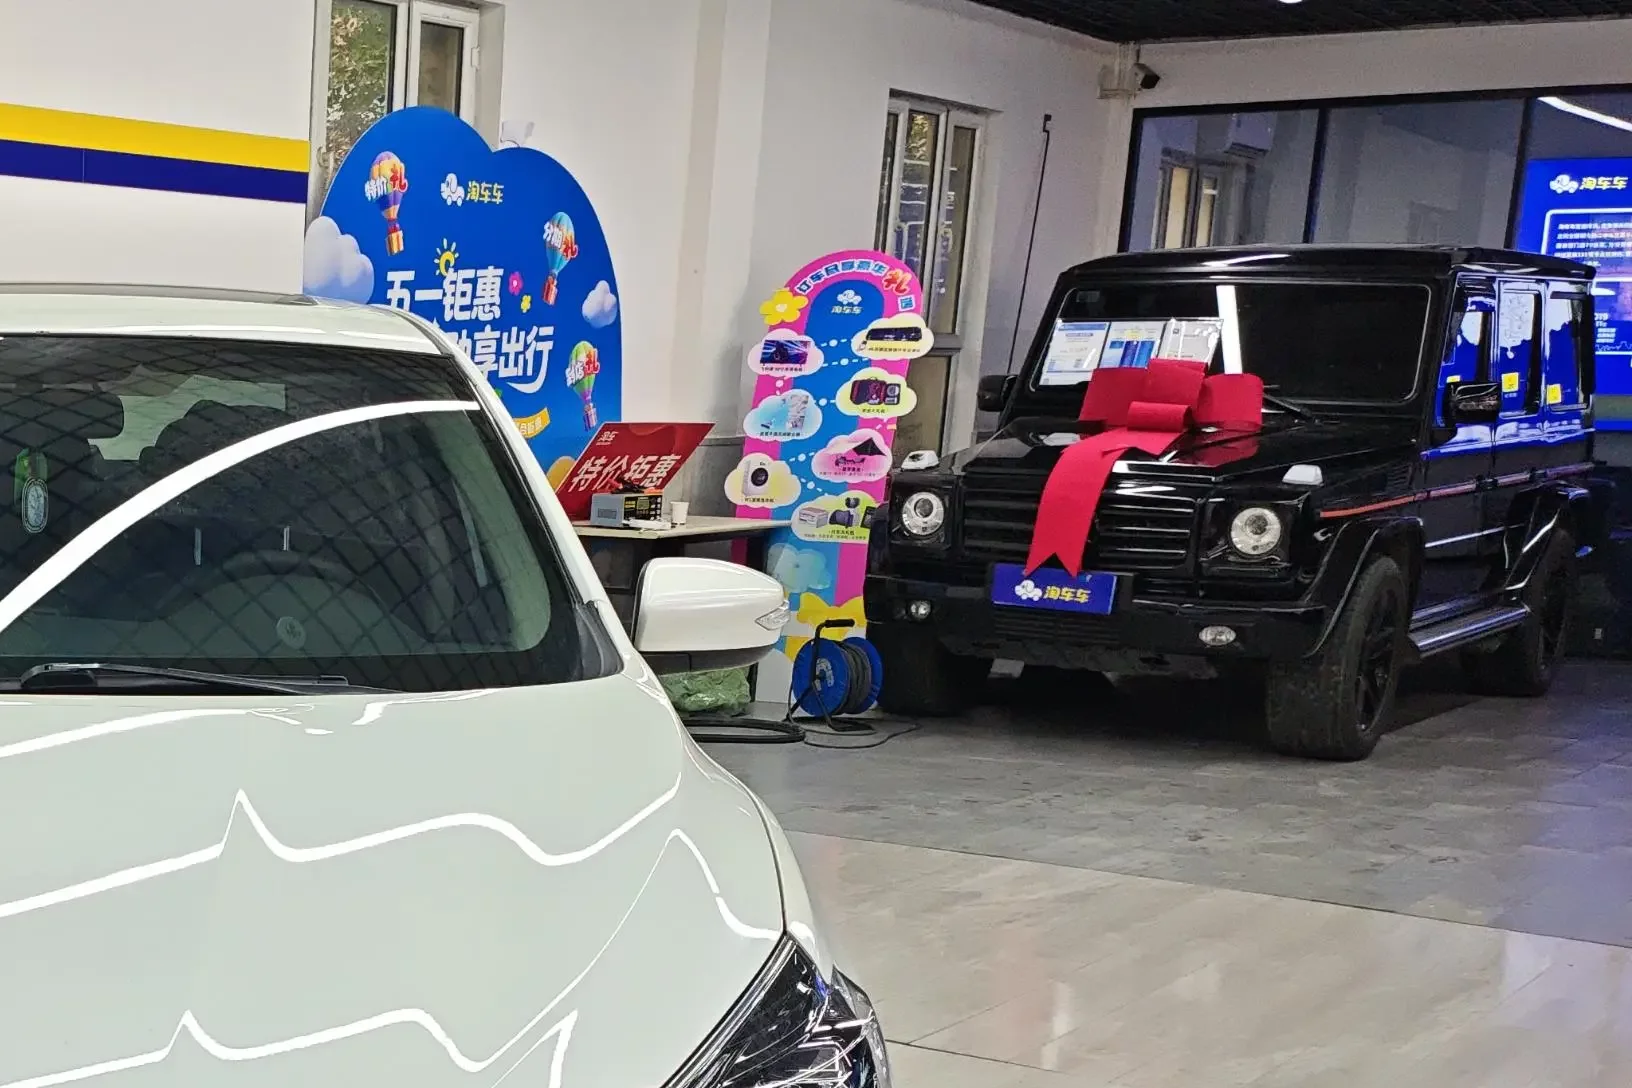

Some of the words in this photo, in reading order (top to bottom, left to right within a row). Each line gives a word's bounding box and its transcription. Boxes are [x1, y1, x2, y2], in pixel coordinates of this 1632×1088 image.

[466, 180, 505, 204] 淘车车
[1579, 176, 1628, 190] 淘车车
[386, 265, 505, 322] 五一钜惠
[568, 453, 682, 493] 特价钜惠
[1043, 585, 1091, 604] 淘车车
